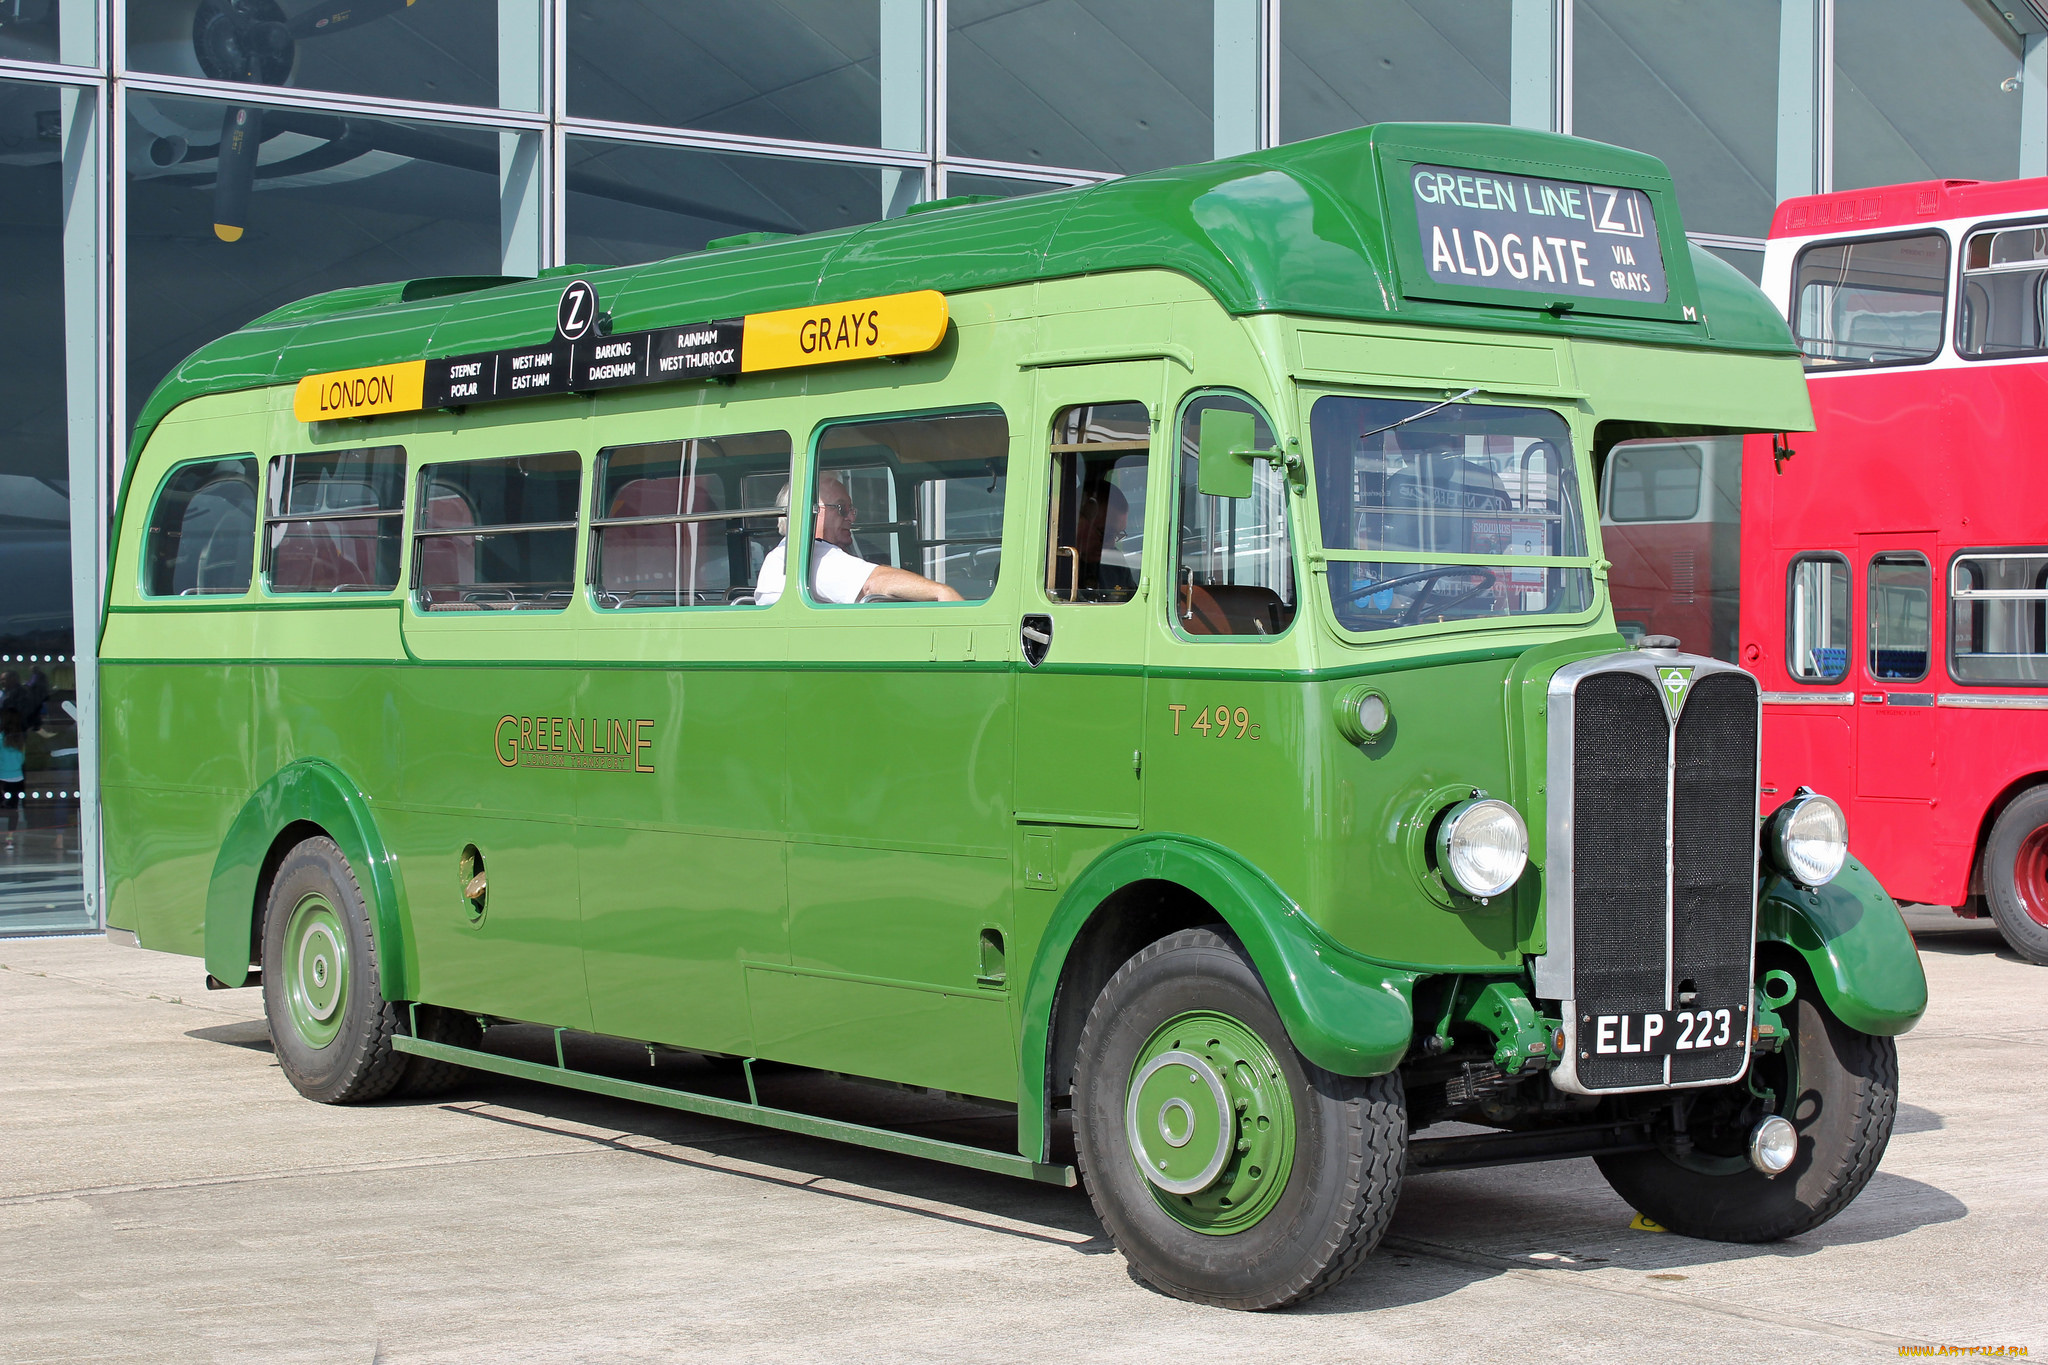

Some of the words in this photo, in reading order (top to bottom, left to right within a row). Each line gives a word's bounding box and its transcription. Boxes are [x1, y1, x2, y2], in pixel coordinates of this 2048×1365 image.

[1414, 171, 1518, 213] GREEN
[1523, 183, 1586, 220] LINE
[1433, 225, 1595, 287] ALDGATE
[1611, 245, 1636, 266] VIA
[1609, 271, 1650, 293] GRAYS
[565, 290, 585, 331] Z
[1682, 305, 1697, 321] M
[677, 329, 718, 349] RAINHAM
[800, 310, 879, 354] GRAYS
[512, 355, 534, 370] WEST
[534, 352, 553, 367] HAM
[595, 342, 632, 359] BARKING
[659, 356, 683, 372] WEST
[685, 348, 735, 368] THURROCK
[450, 362, 482, 379] STEPNEY
[511, 374, 532, 390] EAST
[532, 372, 550, 386] HAM
[589, 362, 636, 381] DAGENHAM
[320, 374, 394, 411] LONDON
[450, 382, 478, 398] POPLAR
[1525, 540, 1532, 553] 6
[1168, 703, 1187, 736] T
[494, 714, 585, 767] GREEN
[592, 718, 655, 773] LINE
[526, 753, 565, 767] LONDON
[571, 756, 625, 769] TRANSPORT
[1596, 1013, 1664, 1054] ELP
[1676, 1009, 1731, 1050] 223
